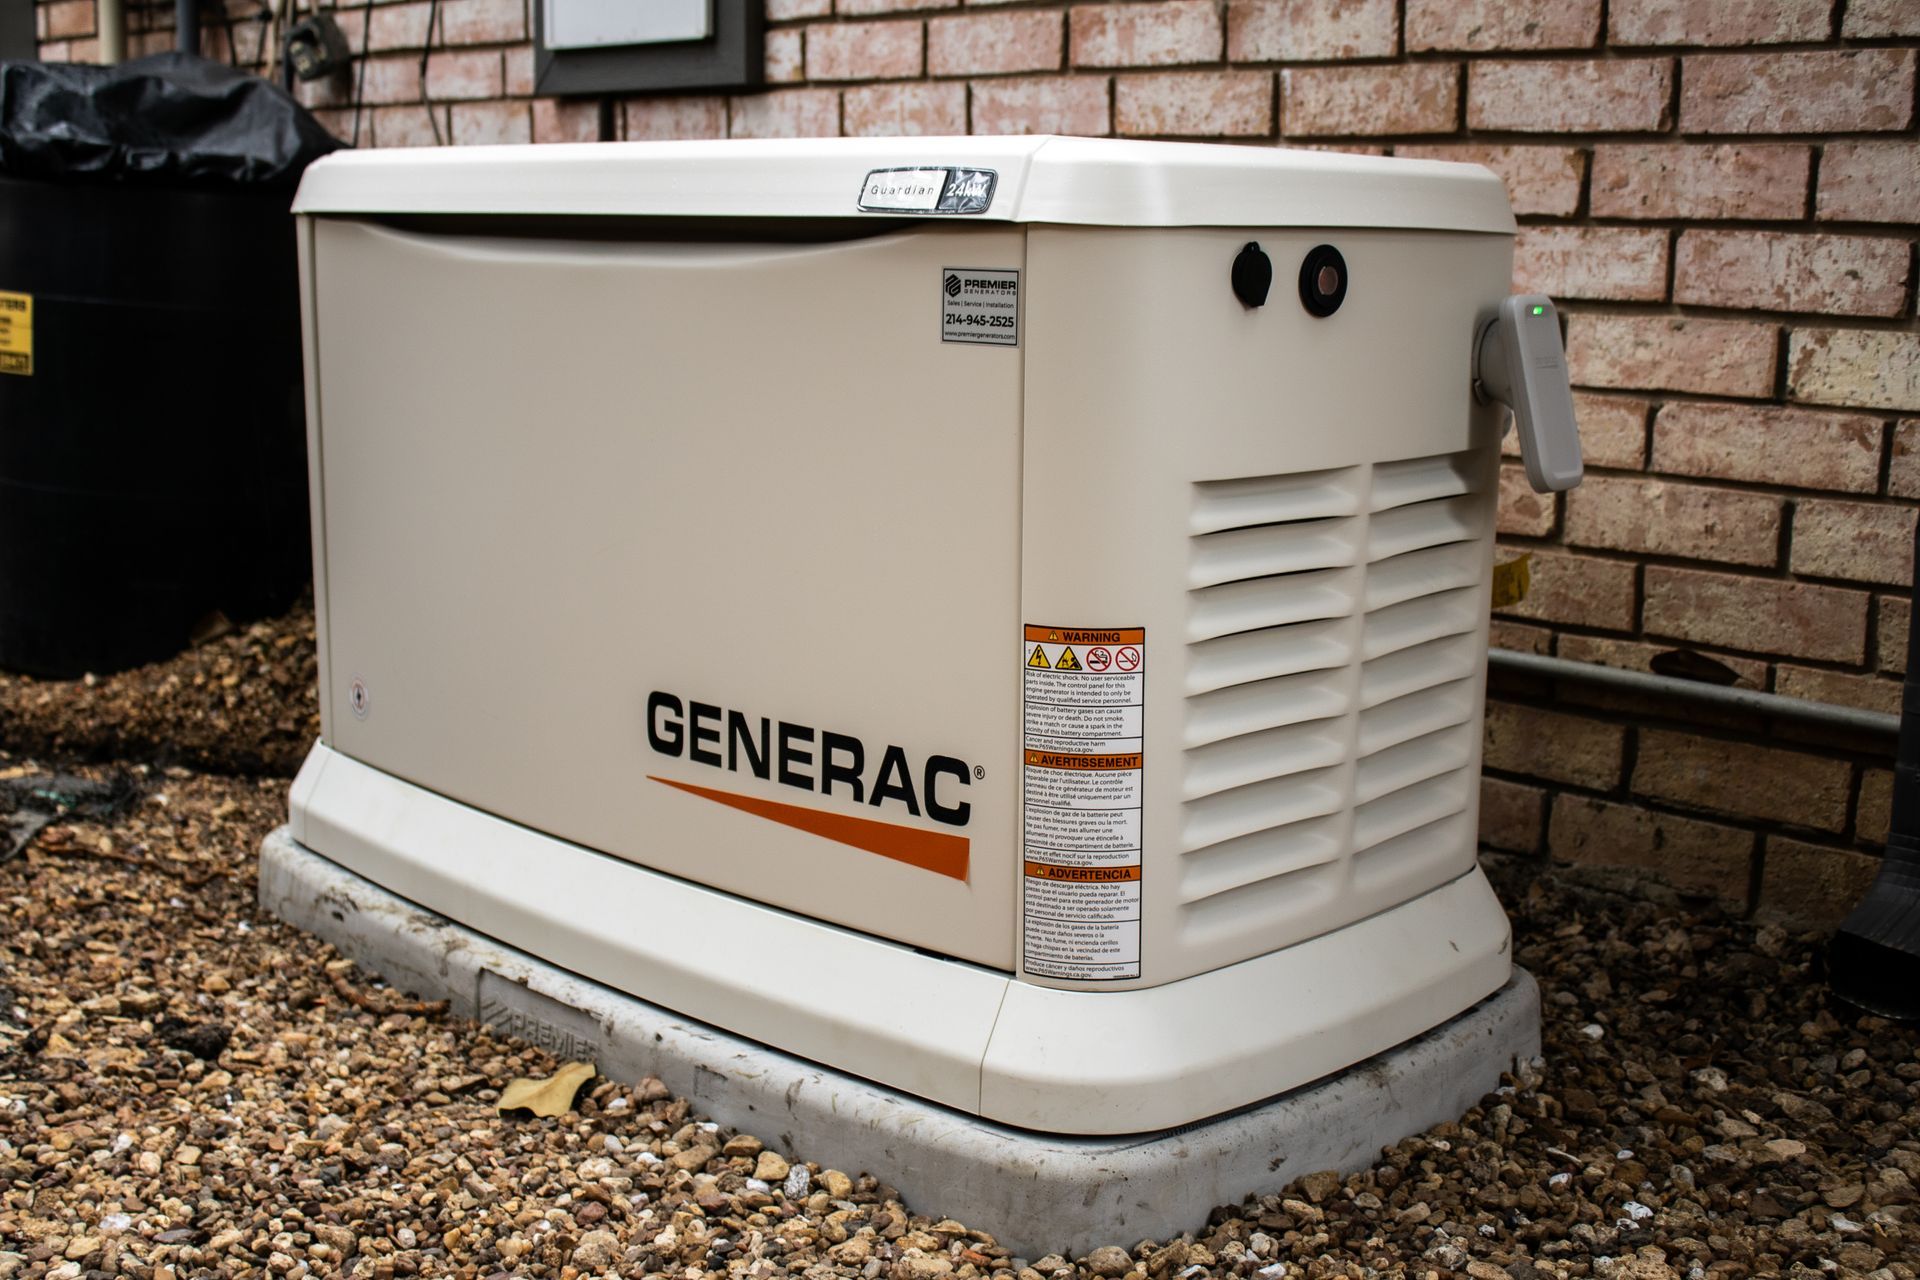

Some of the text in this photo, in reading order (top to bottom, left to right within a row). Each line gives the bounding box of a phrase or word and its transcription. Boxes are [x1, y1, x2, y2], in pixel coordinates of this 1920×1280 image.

[871, 185, 934, 194] Guardian
[964, 279, 1016, 290] PREMIER
[946, 314, 1014, 327] 214-945-2525
[1063, 632, 1120, 642] WARNING
[1042, 755, 1138, 767] AVERTISSEMENT
[1048, 868, 1131, 880] ADVERTENCIA
